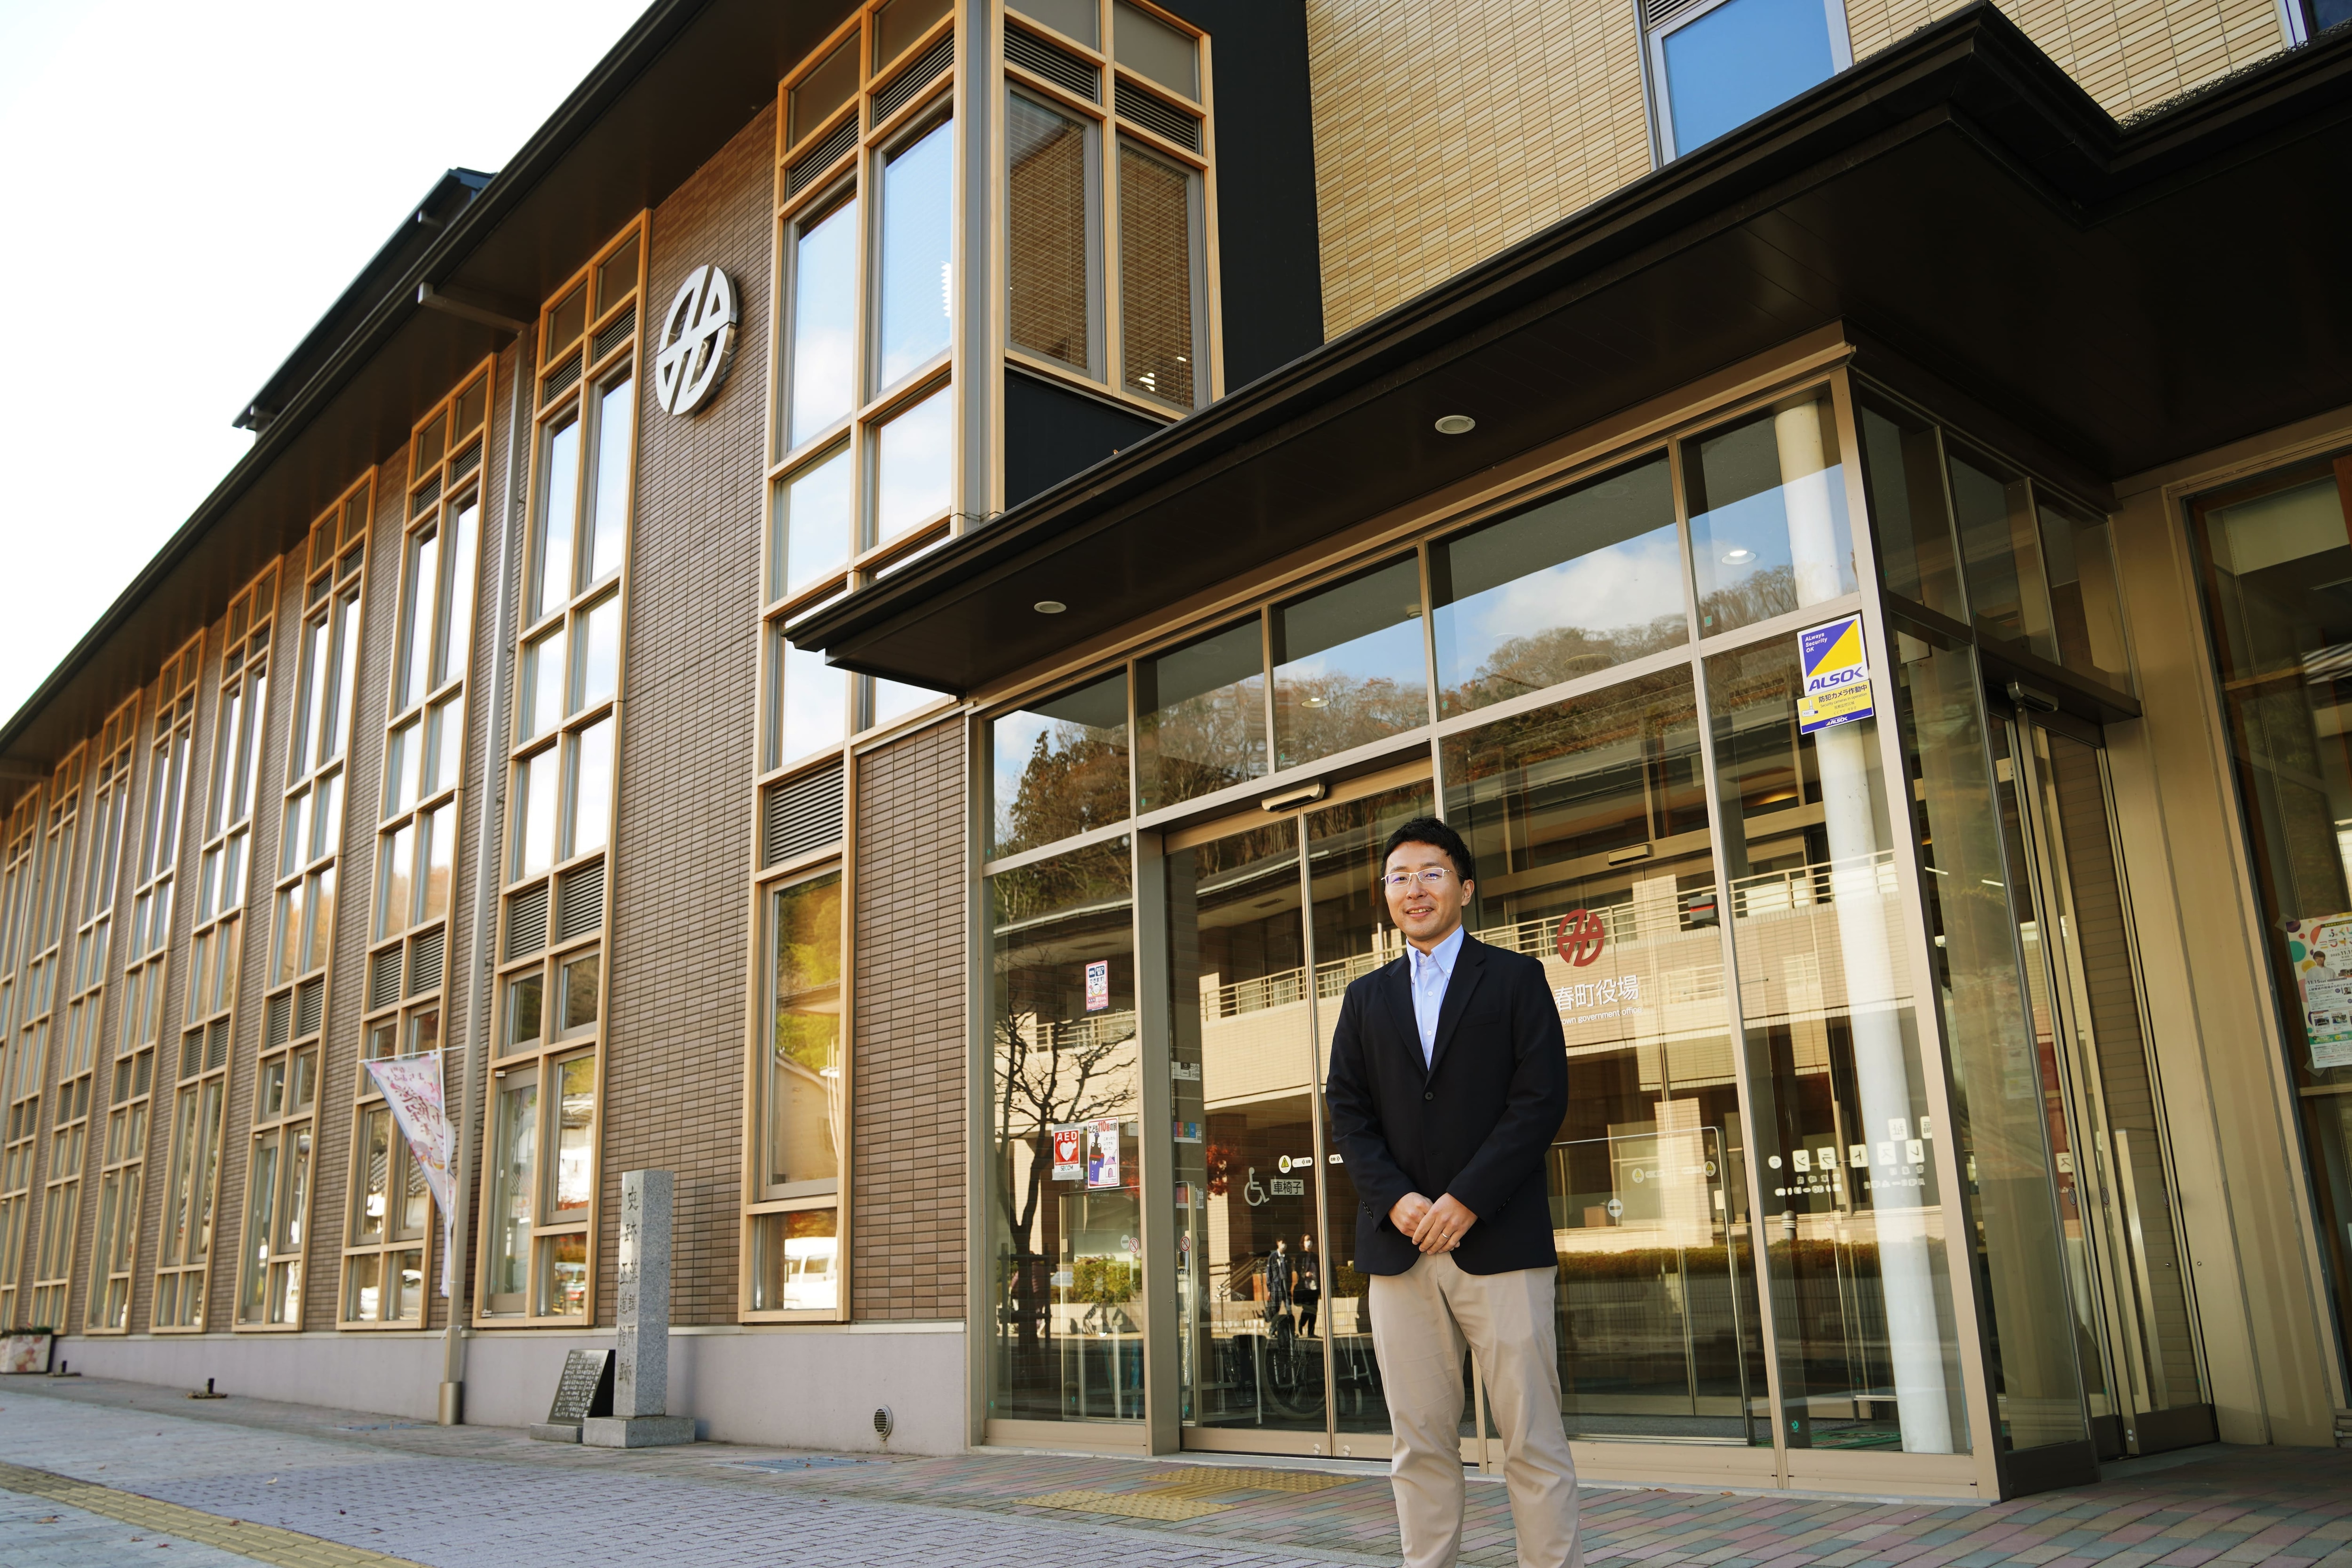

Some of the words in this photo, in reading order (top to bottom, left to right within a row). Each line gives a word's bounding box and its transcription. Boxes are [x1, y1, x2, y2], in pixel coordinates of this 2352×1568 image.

[1805, 632, 1825, 642] ALways
[1805, 637, 1828, 647] Security
[1809, 666, 1864, 692] ALSOK
[1819, 684, 1867, 703] 防犯カメラ作動中
[1830, 716, 1848, 725] ALSOK
[1560, 1017, 1576, 1026] own
[1578, 1010, 1620, 1024] government
[1621, 1006, 1643, 1015] office
[1089, 1121, 1117, 1133] こども110番の家
[1056, 1131, 1077, 1142] AED
[1273, 1180, 1302, 1194] 車椅子
